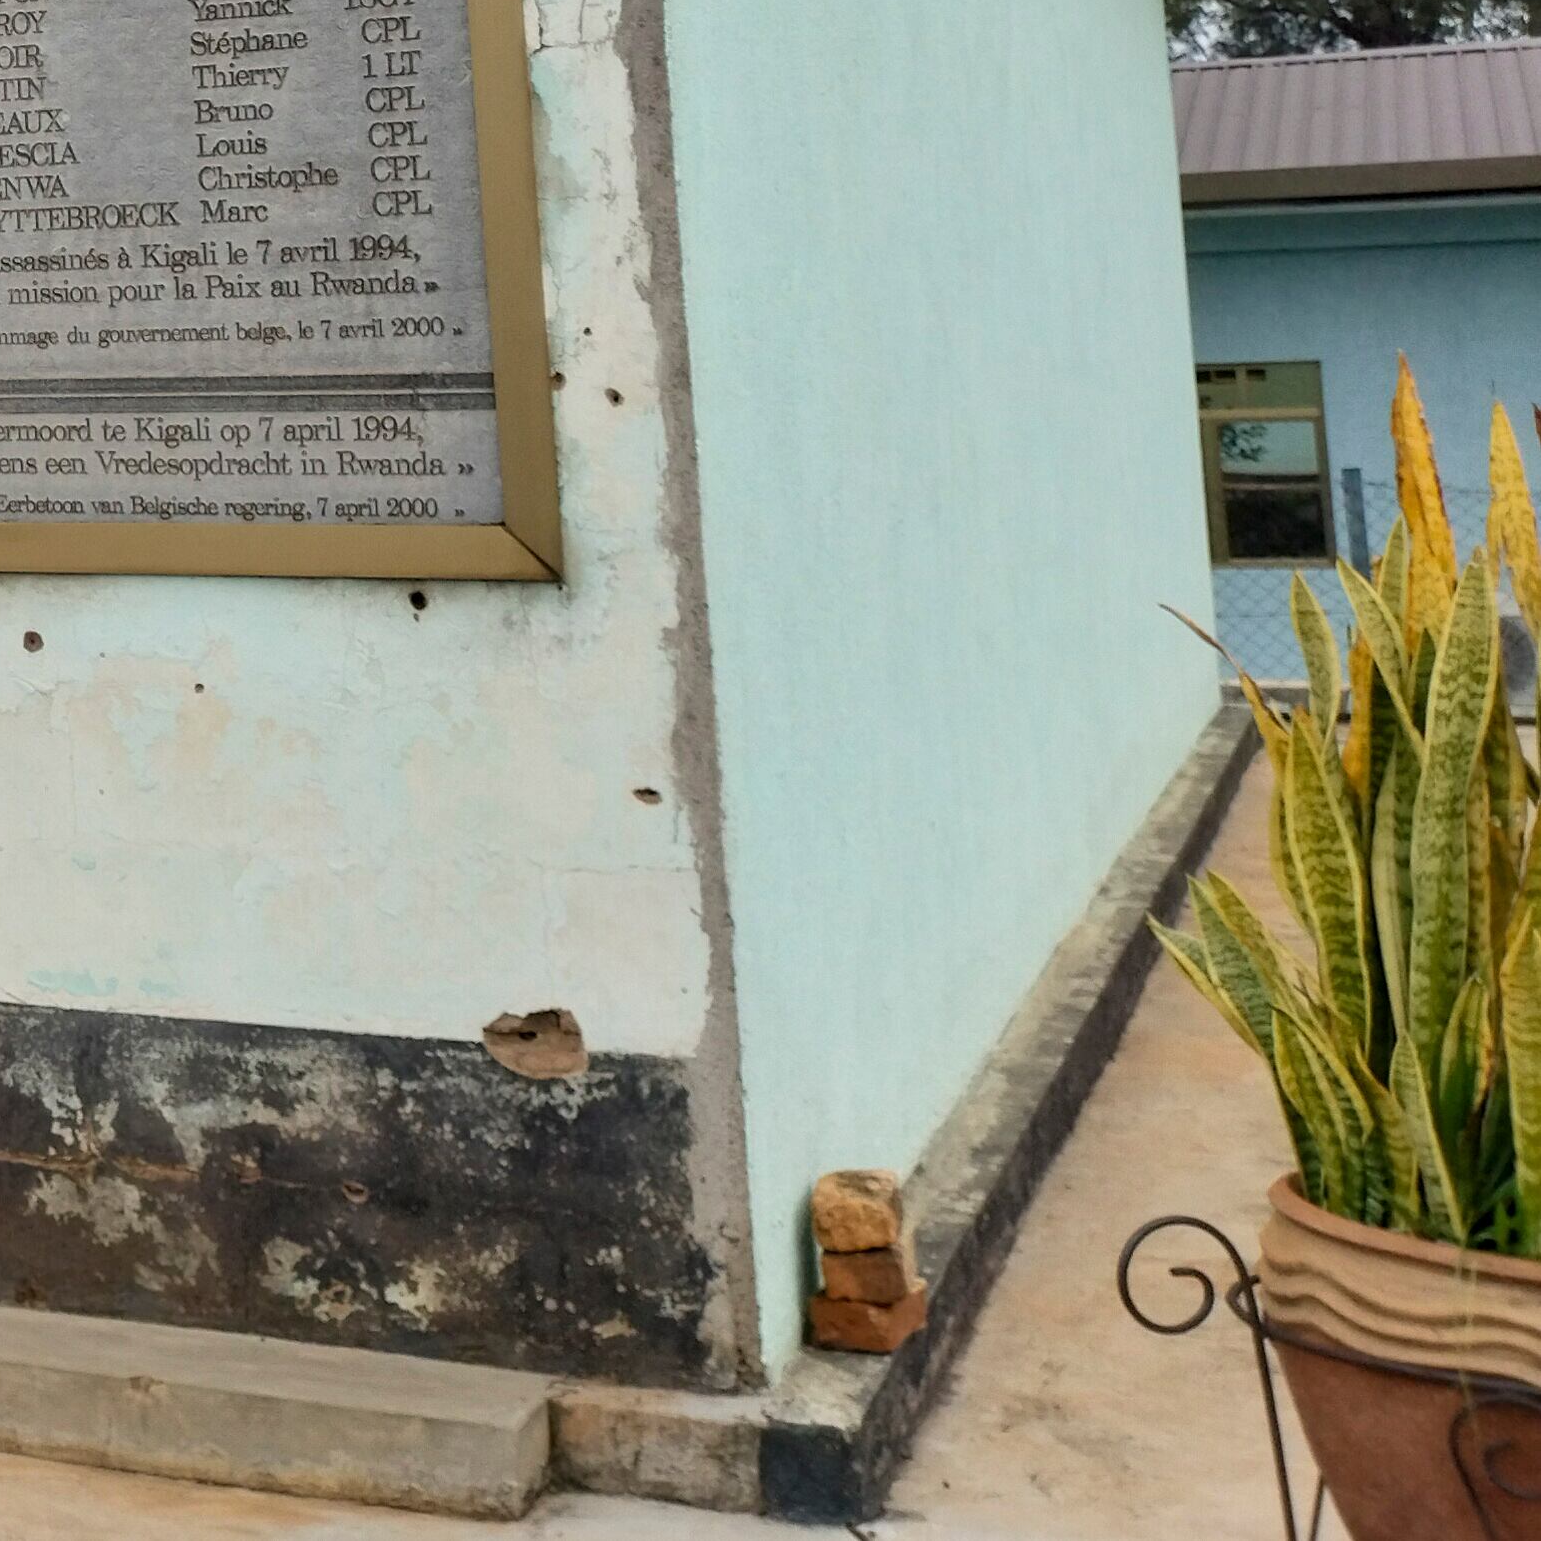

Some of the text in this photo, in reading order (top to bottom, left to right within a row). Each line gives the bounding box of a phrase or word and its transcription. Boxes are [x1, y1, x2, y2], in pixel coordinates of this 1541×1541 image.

[190, 26, 309, 59] Stéphane
[362, 16, 421, 43] CPL
[192, 63, 289, 89] Thierry
[194, 99, 274, 124] Bruno
[365, 86, 425, 113] CPL
[196, 130, 268, 157] Louis
[368, 121, 428, 148] CPL
[198, 162, 338, 193] Christophe
[371, 155, 431, 182] CPL
[200, 200, 269, 223] Marc
[373, 190, 432, 217] CPL
[117, 248, 132, 269] à
[139, 241, 218, 273] Kigali
[226, 241, 248, 264] le
[256, 240, 272, 264] 7
[280, 237, 340, 264] avril
[349, 234, 420, 263] 1994,
[7, 280, 99, 304] mission
[108, 282, 165, 307] pour
[174, 277, 197, 300] la
[205, 274, 262, 299] Paix
[271, 280, 302, 297] au
[310, 269, 418, 296] Rwanda
[67, 326, 90, 345] du
[98, 323, 230, 348] gouvernement
[236, 322, 292, 345] belge,
[297, 321, 314, 339] le
[320, 320, 332, 338] 7
[339, 318, 385, 338] avril
[392, 316, 445, 337] 2000
[102, 420, 126, 442] te
[134, 417, 212, 448] Kigali
[220, 424, 251, 447] op
[259, 417, 274, 442] 7
[283, 416, 344, 447] april
[351, 415, 424, 446] 1994,
[46, 459, 88, 474] een
[95, 451, 292, 481] Vredesopdracht
[301, 451, 326, 475] in
[336, 451, 446, 476] Rwanda
[90, 501, 124, 515] van
[130, 496, 219, 519] Belgische
[224, 498, 312, 521] regering,
[317, 497, 329, 517] 7
[335, 497, 379, 522] april
[386, 497, 438, 517] 2000
